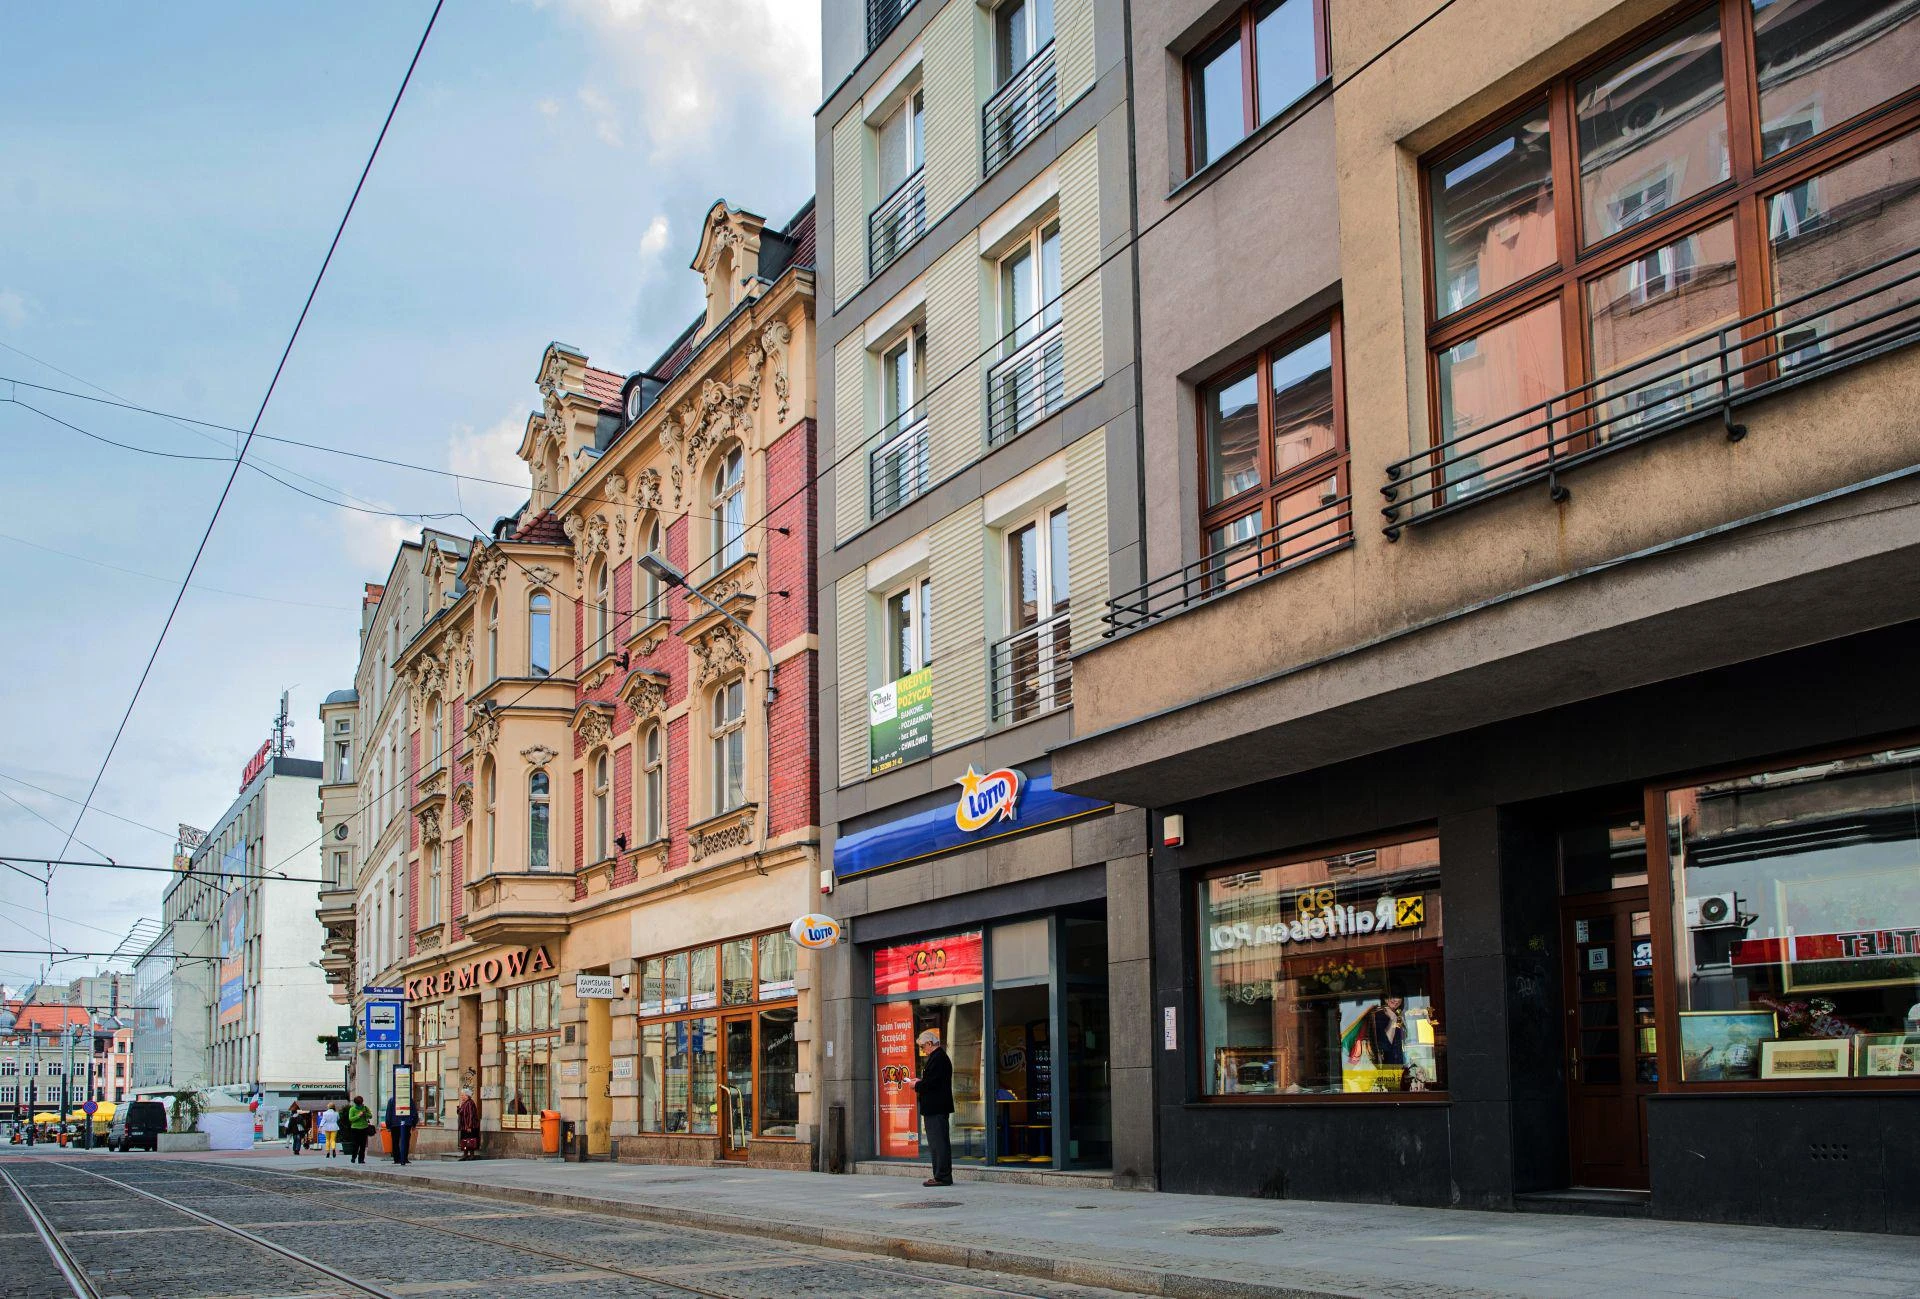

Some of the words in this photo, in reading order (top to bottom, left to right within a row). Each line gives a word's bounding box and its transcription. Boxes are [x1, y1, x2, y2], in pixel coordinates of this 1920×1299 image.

[969, 780, 1005, 819] LOTTO
[808, 926, 833, 941] LOTTO
[406, 945, 555, 1000] KREMOWA
[876, 1021, 894, 1031] Zanim
[894, 1019, 912, 1031] Twoje
[881, 1032, 907, 1043] Szczęście
